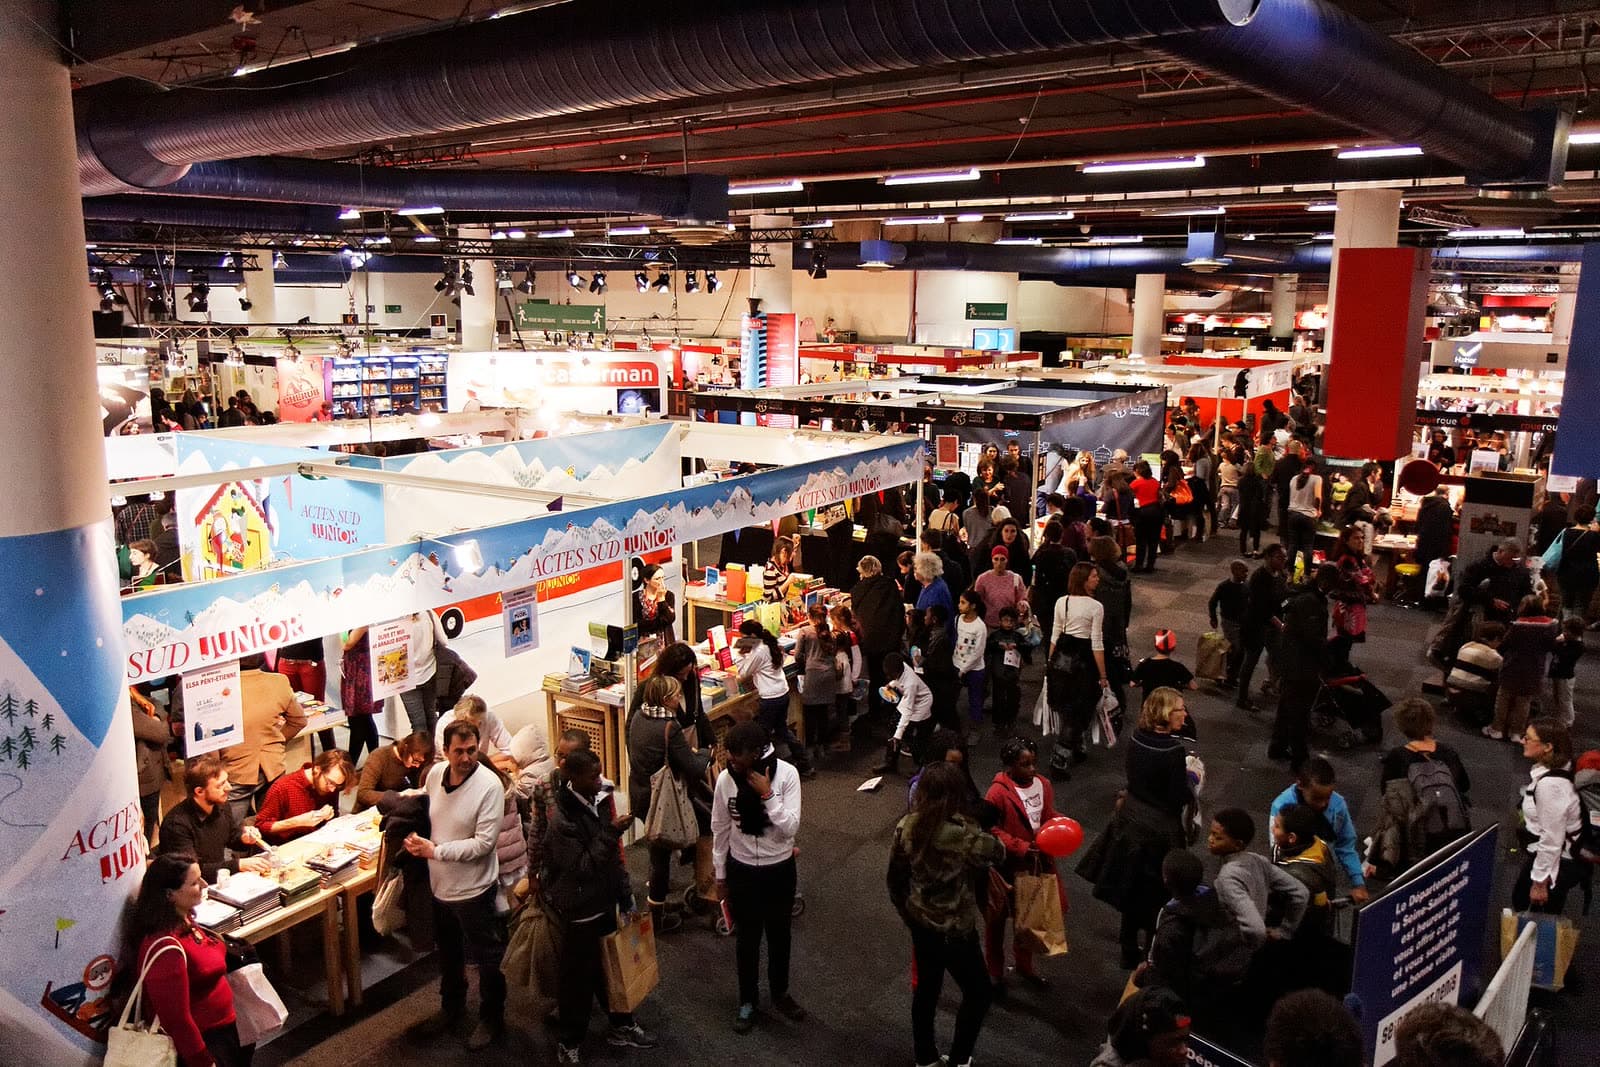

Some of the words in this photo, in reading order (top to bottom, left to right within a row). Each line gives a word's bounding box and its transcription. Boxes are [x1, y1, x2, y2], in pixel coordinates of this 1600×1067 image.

[544, 367, 653, 383] casrman
[796, 488, 826, 510] ACTES
[829, 484, 848, 501] SUD
[301, 505, 336, 523] ACTES
[337, 510, 361, 529] SUD
[530, 548, 585, 579] ACTES
[588, 540, 621, 564] SUD
[127, 642, 190, 680] SUD
[186, 680, 200, 690] ELSA
[99, 832, 142, 885] JUN
[1186, 1047, 1220, 1067] Dép
